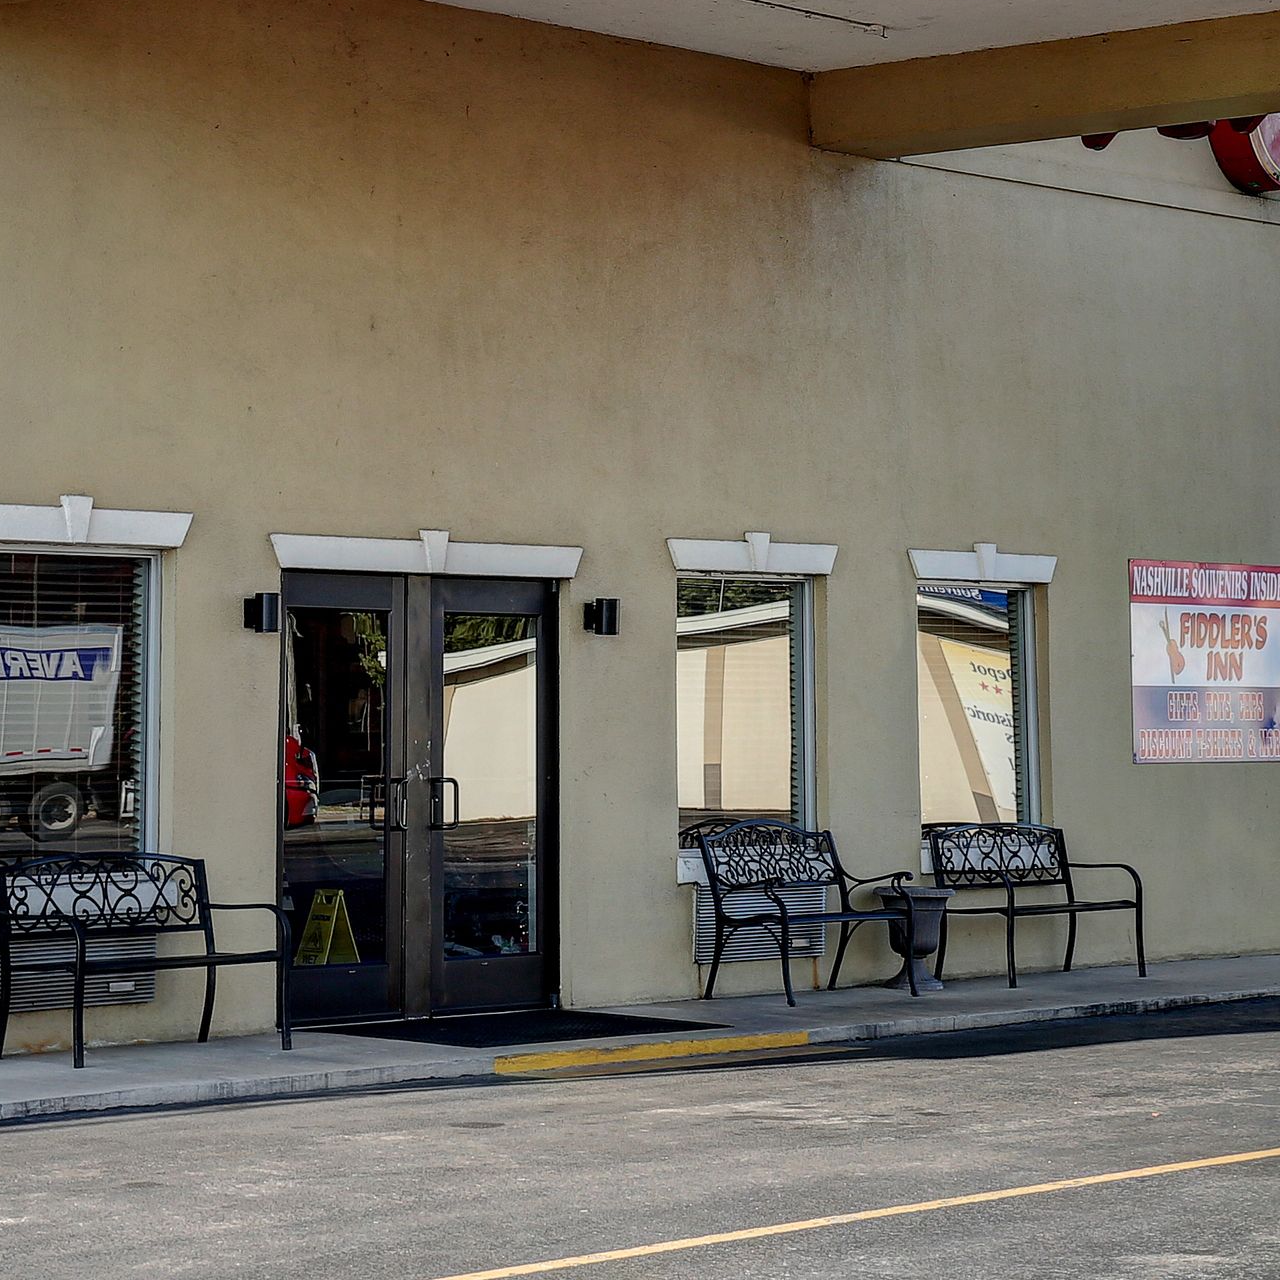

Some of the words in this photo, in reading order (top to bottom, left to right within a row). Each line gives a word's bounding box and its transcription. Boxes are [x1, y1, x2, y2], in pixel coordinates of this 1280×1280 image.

[1132, 566, 1190, 597] NASHVILLE
[1192, 569, 1248, 600] SOUVENIRS
[1180, 612, 1268, 650] FIDDLER'S
[1206, 651, 1244, 682] INN
[1167, 692, 1201, 723] GIFTS,
[1205, 692, 1234, 723] TOYS,
[1139, 729, 1193, 759] DISCOUNT
[1196, 729, 1243, 758] T-SHIRTS
[1248, 729, 1257, 758] &
